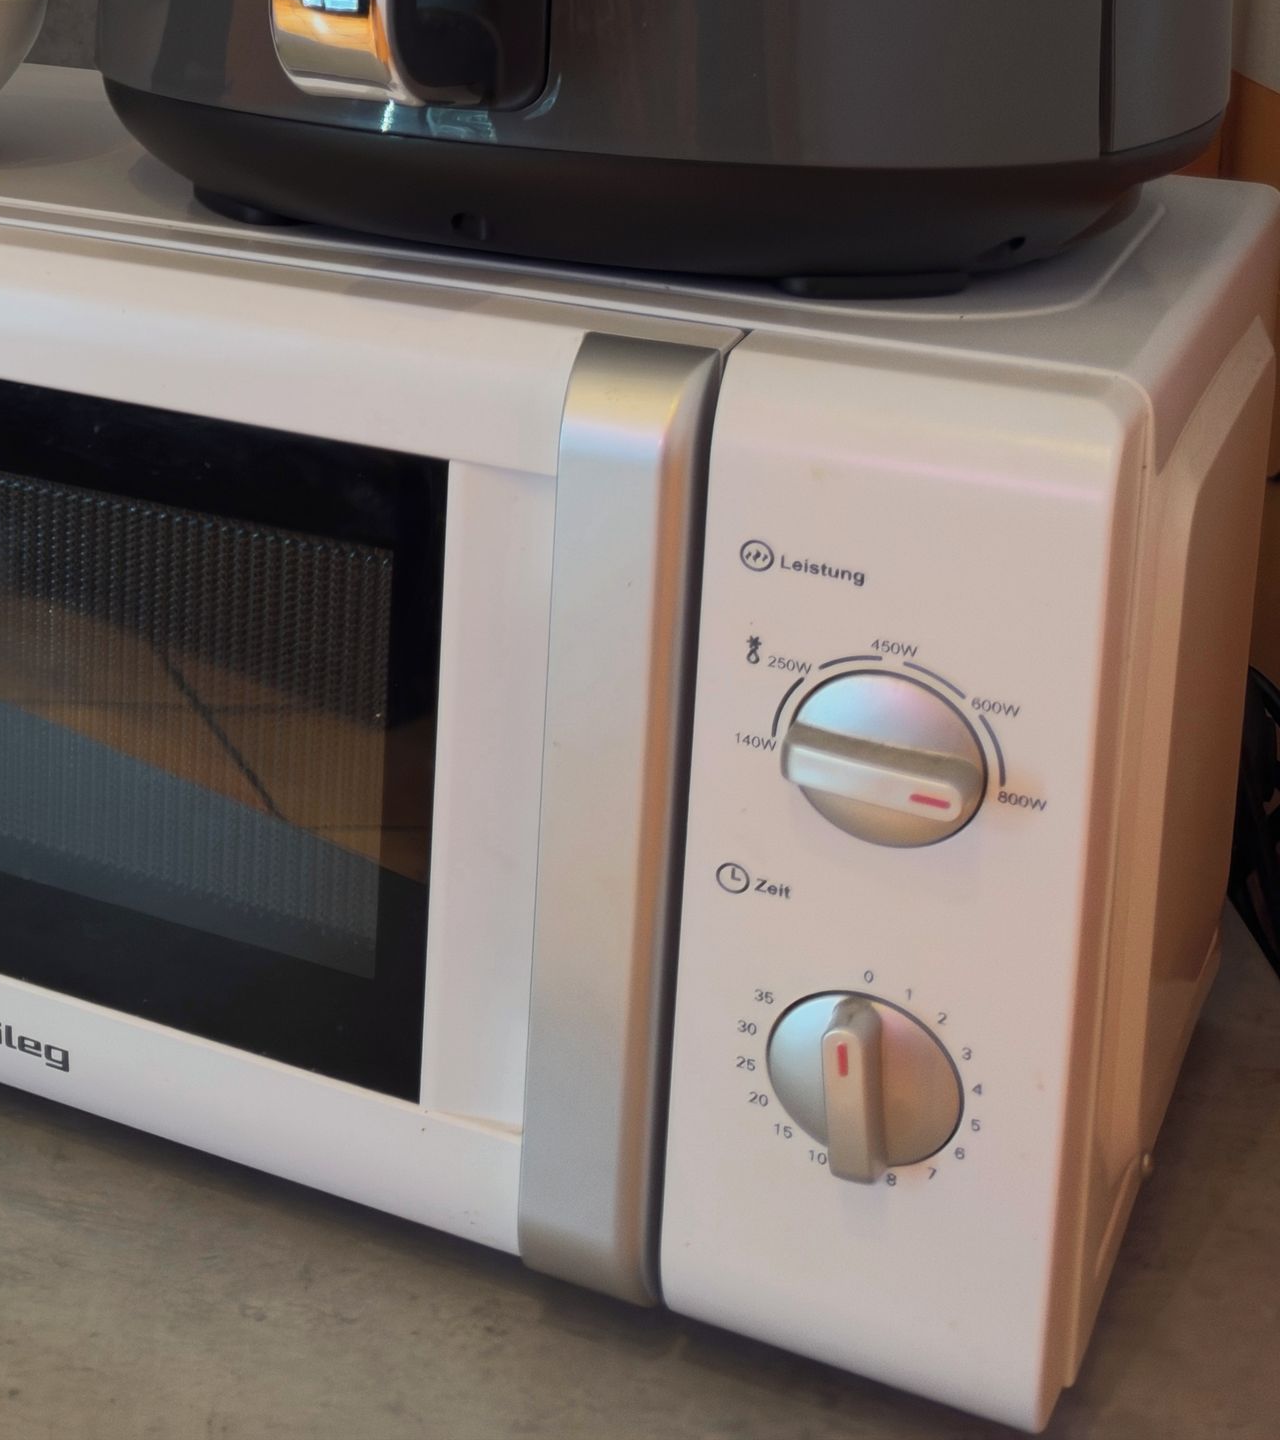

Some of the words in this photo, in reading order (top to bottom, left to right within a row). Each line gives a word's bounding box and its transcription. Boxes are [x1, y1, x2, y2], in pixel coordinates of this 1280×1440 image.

[780, 555, 866, 587] Leistung
[870, 638, 919, 658] 450W
[767, 655, 812, 675] 250W
[970, 697, 1021, 718] 600W
[735, 732, 777, 752] 140W
[997, 790, 1047, 811] 800W
[754, 878, 792, 900] Zeit
[863, 970, 874, 984] 0
[754, 989, 775, 1005] 35
[904, 988, 913, 1001] 1
[937, 1012, 948, 1025] 2
[737, 1020, 758, 1036] 30
[961, 1047, 973, 1061] 3
[736, 1056, 757, 1072] 25
[972, 1083, 983, 1096] 4
[748, 1092, 769, 1108] 20
[773, 1123, 793, 1140] 15
[970, 1119, 981, 1133] 5
[808, 1149, 828, 1166] 10
[954, 1147, 966, 1160] 6
[886, 1173, 897, 1187] 8
[927, 1166, 937, 1181] 7
